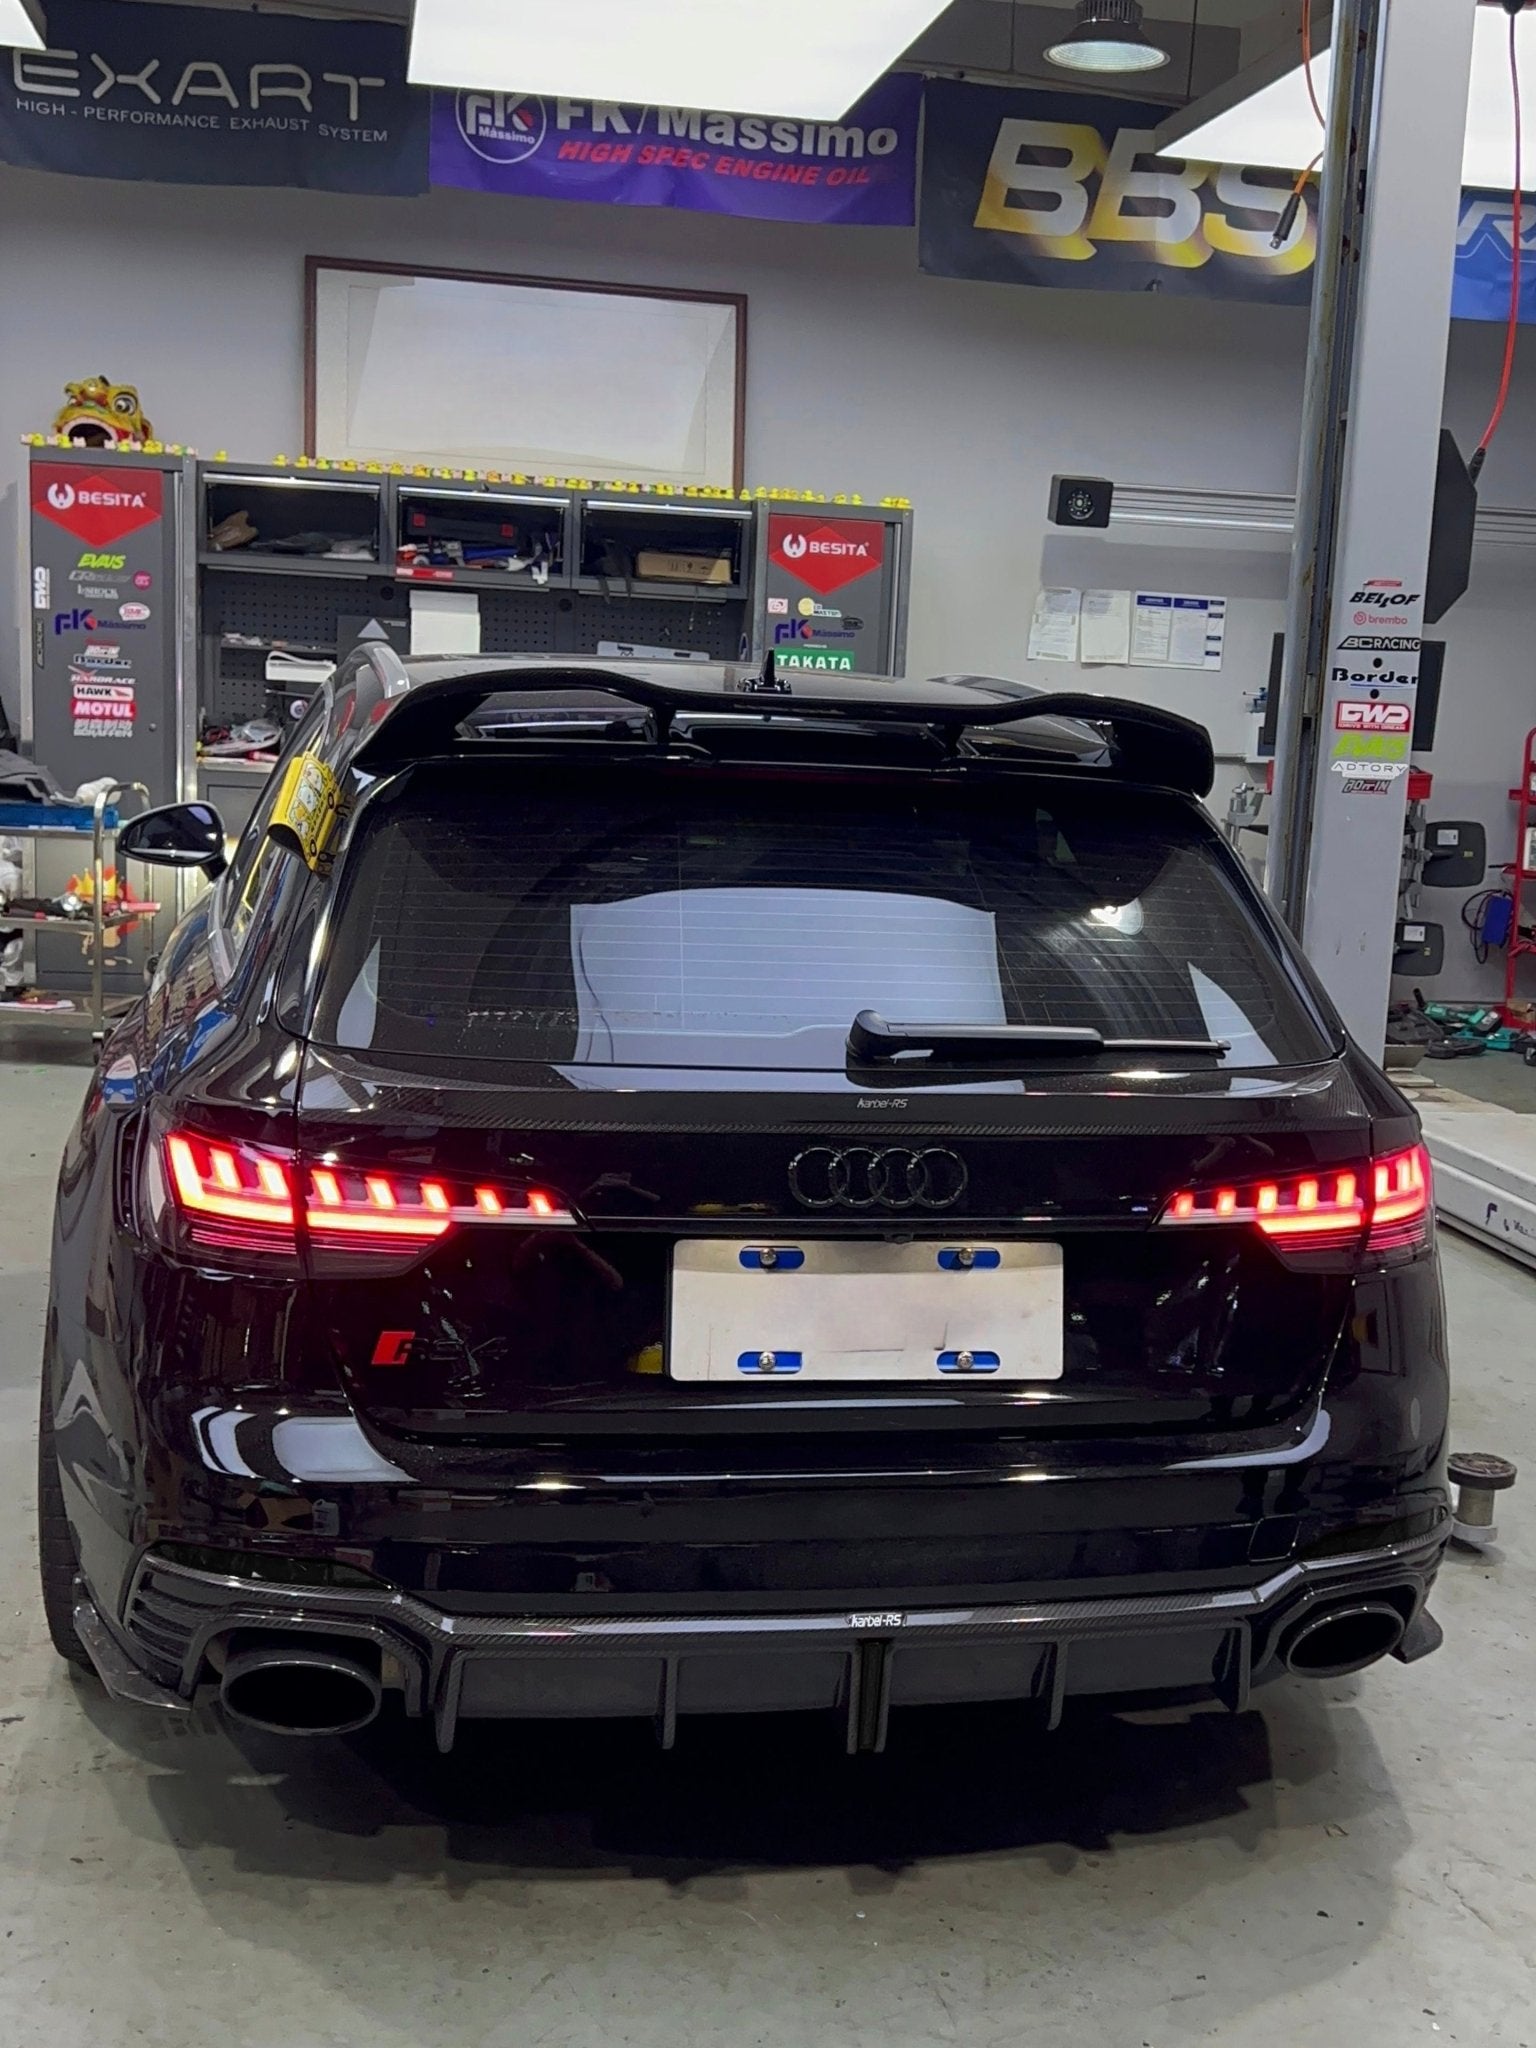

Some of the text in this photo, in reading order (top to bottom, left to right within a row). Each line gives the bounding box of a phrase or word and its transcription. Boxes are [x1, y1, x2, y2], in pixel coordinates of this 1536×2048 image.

[13, 48, 386, 121] EXART
[16, 98, 66, 117] HIGH
[84, 107, 221, 130] PERFORMANCE
[229, 117, 311, 132] EXHAUST
[318, 122, 389, 143] SYSTEM
[558, 140, 874, 187] HIGH SPEC ENGINE OIL
[973, 117, 1318, 277] BBS
[1368, 613, 1409, 626] brembo
[776, 654, 851, 671] TAKATA
[1331, 667, 1418, 685] Border
[76, 686, 113, 697] HAWK
[73, 701, 134, 717] MOTUL
